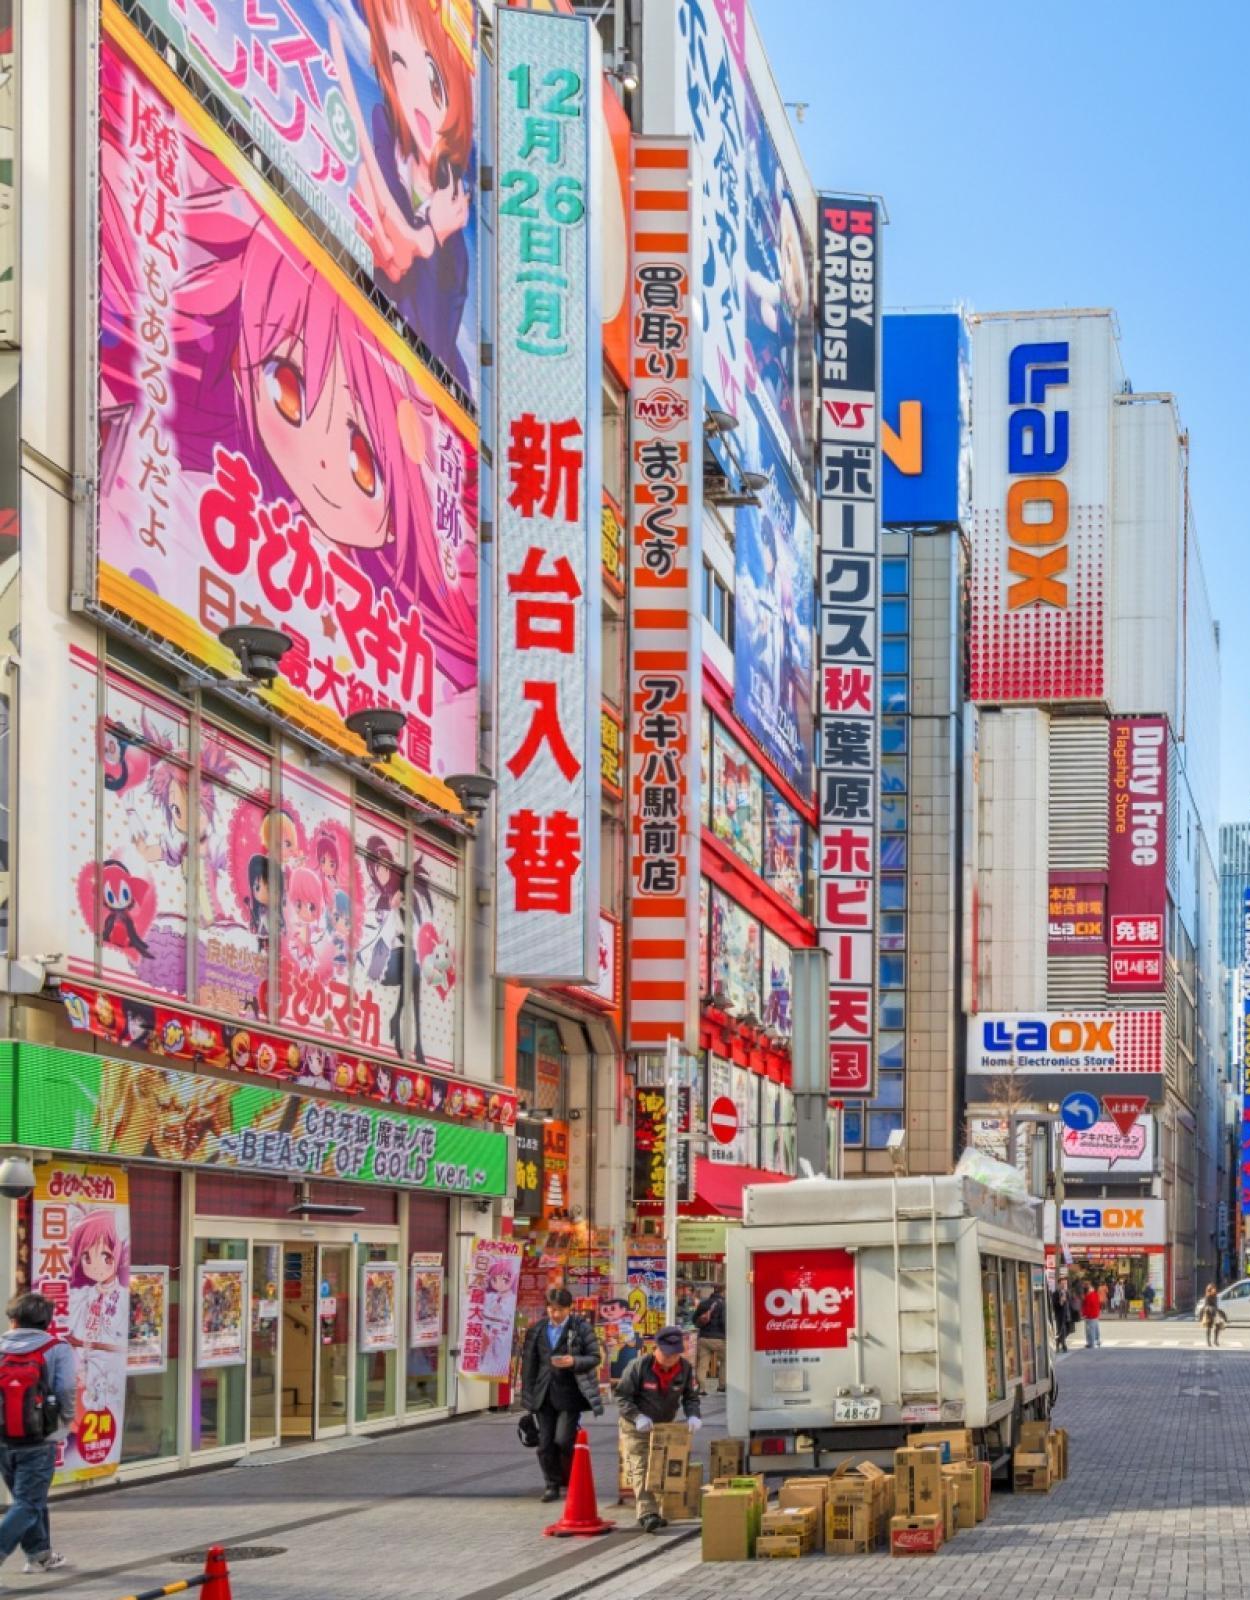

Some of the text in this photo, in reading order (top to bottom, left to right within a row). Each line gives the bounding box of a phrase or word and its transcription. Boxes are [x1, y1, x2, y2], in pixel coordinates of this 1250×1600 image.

[823, 208, 848, 381] PARADISE
[848, 210, 873, 327] HOBBY
[502, 414, 586, 915] 新台入替
[1114, 726, 1130, 834] Flagship Store
[1129, 726, 1164, 867] Duty Free
[1116, 921, 1159, 942] 免税
[981, 1055, 1115, 1067] Home Electronics Store
[335, 1146, 365, 1174] OF
[374, 1151, 428, 1182] GOLD
[843, 1406, 879, 1420] 48-67
